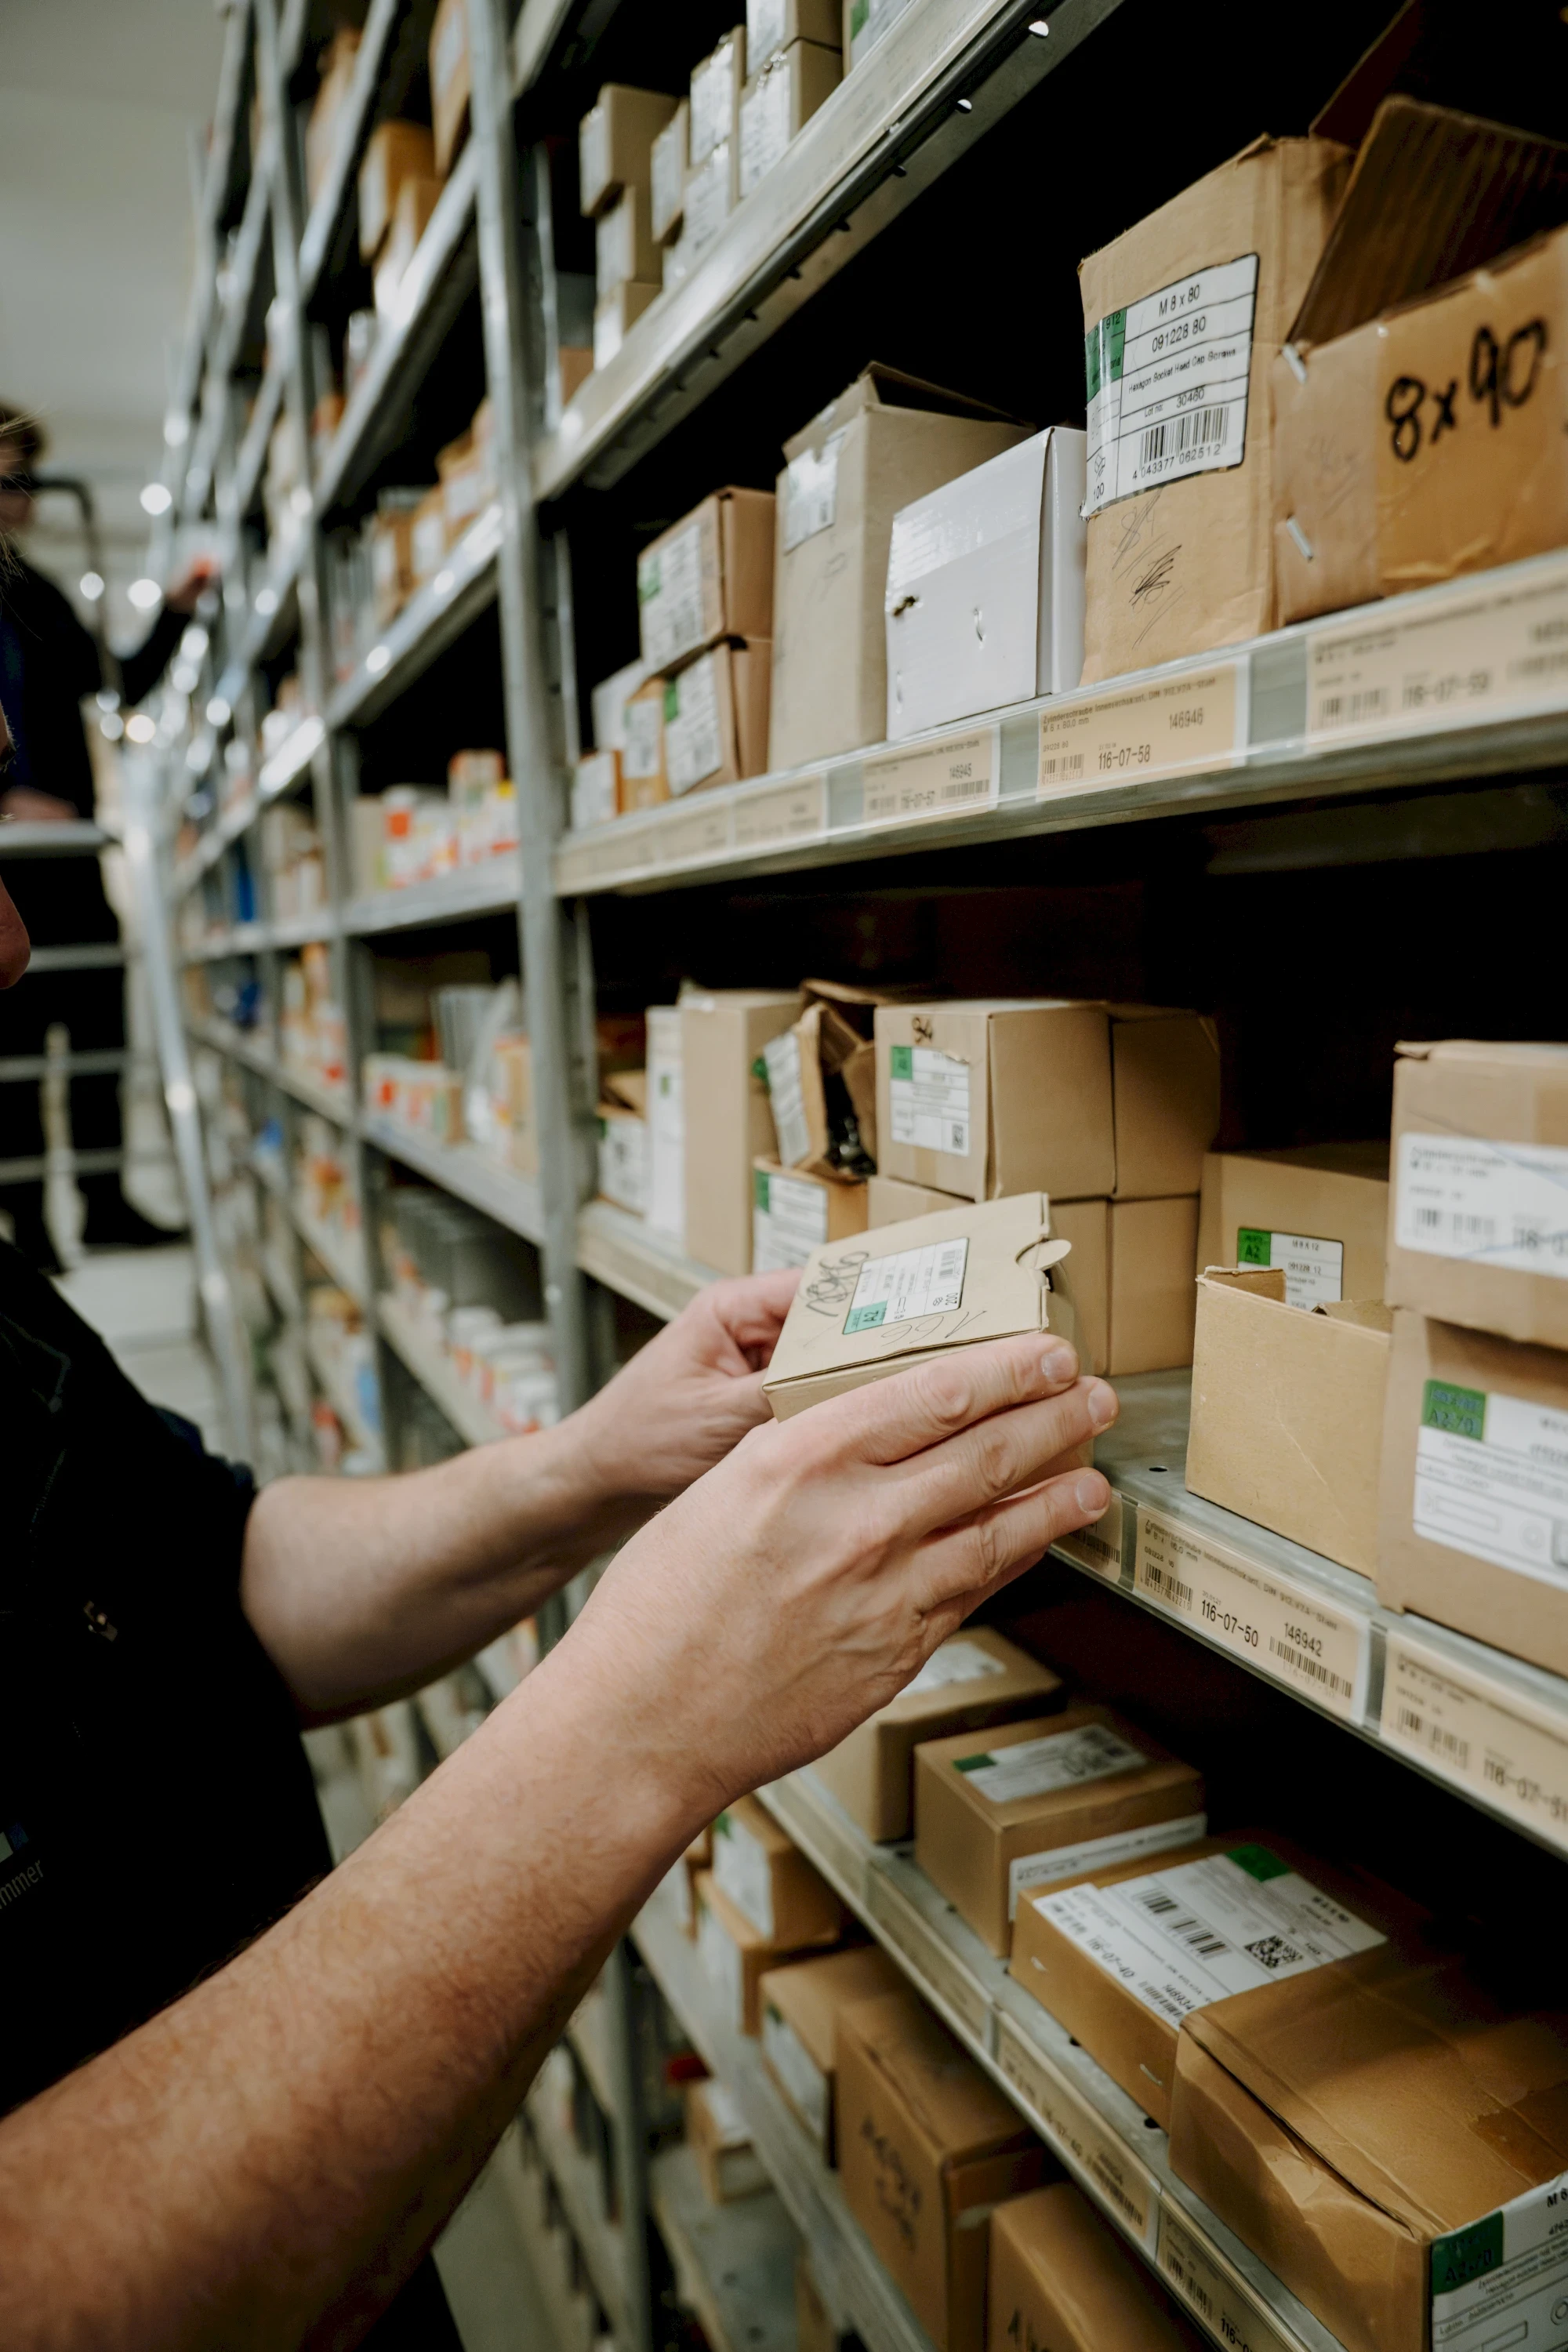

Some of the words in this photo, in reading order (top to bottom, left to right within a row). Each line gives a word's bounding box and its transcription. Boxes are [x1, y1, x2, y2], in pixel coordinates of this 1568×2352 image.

[1159, 299, 1170, 318] M
[1188, 284, 1200, 302] 80
[1105, 313, 1121, 330] 912
[1152, 321, 1189, 353] 091228
[1192, 316, 1207, 336] 80
[1128, 376, 1152, 394] Hexagon
[1153, 367, 1174, 385] Socket
[1174, 360, 1190, 376] Head
[1192, 354, 1206, 368] Cap
[1207, 347, 1236, 363] Screws
[1144, 405, 1154, 418] Lot
[1176, 387, 1205, 408] 30460
[1092, 482, 1105, 503] 100
[1169, 707, 1204, 730] 146946
[1098, 744, 1151, 771] 116-07-58
[945, 1292, 958, 1305] 200
[863, 1309, 879, 1323] A2
[1201, 1599, 1259, 1647] 116-07-50
[1284, 1622, 1323, 1657] 146942
[0, 1860, 43, 1909] mmer
